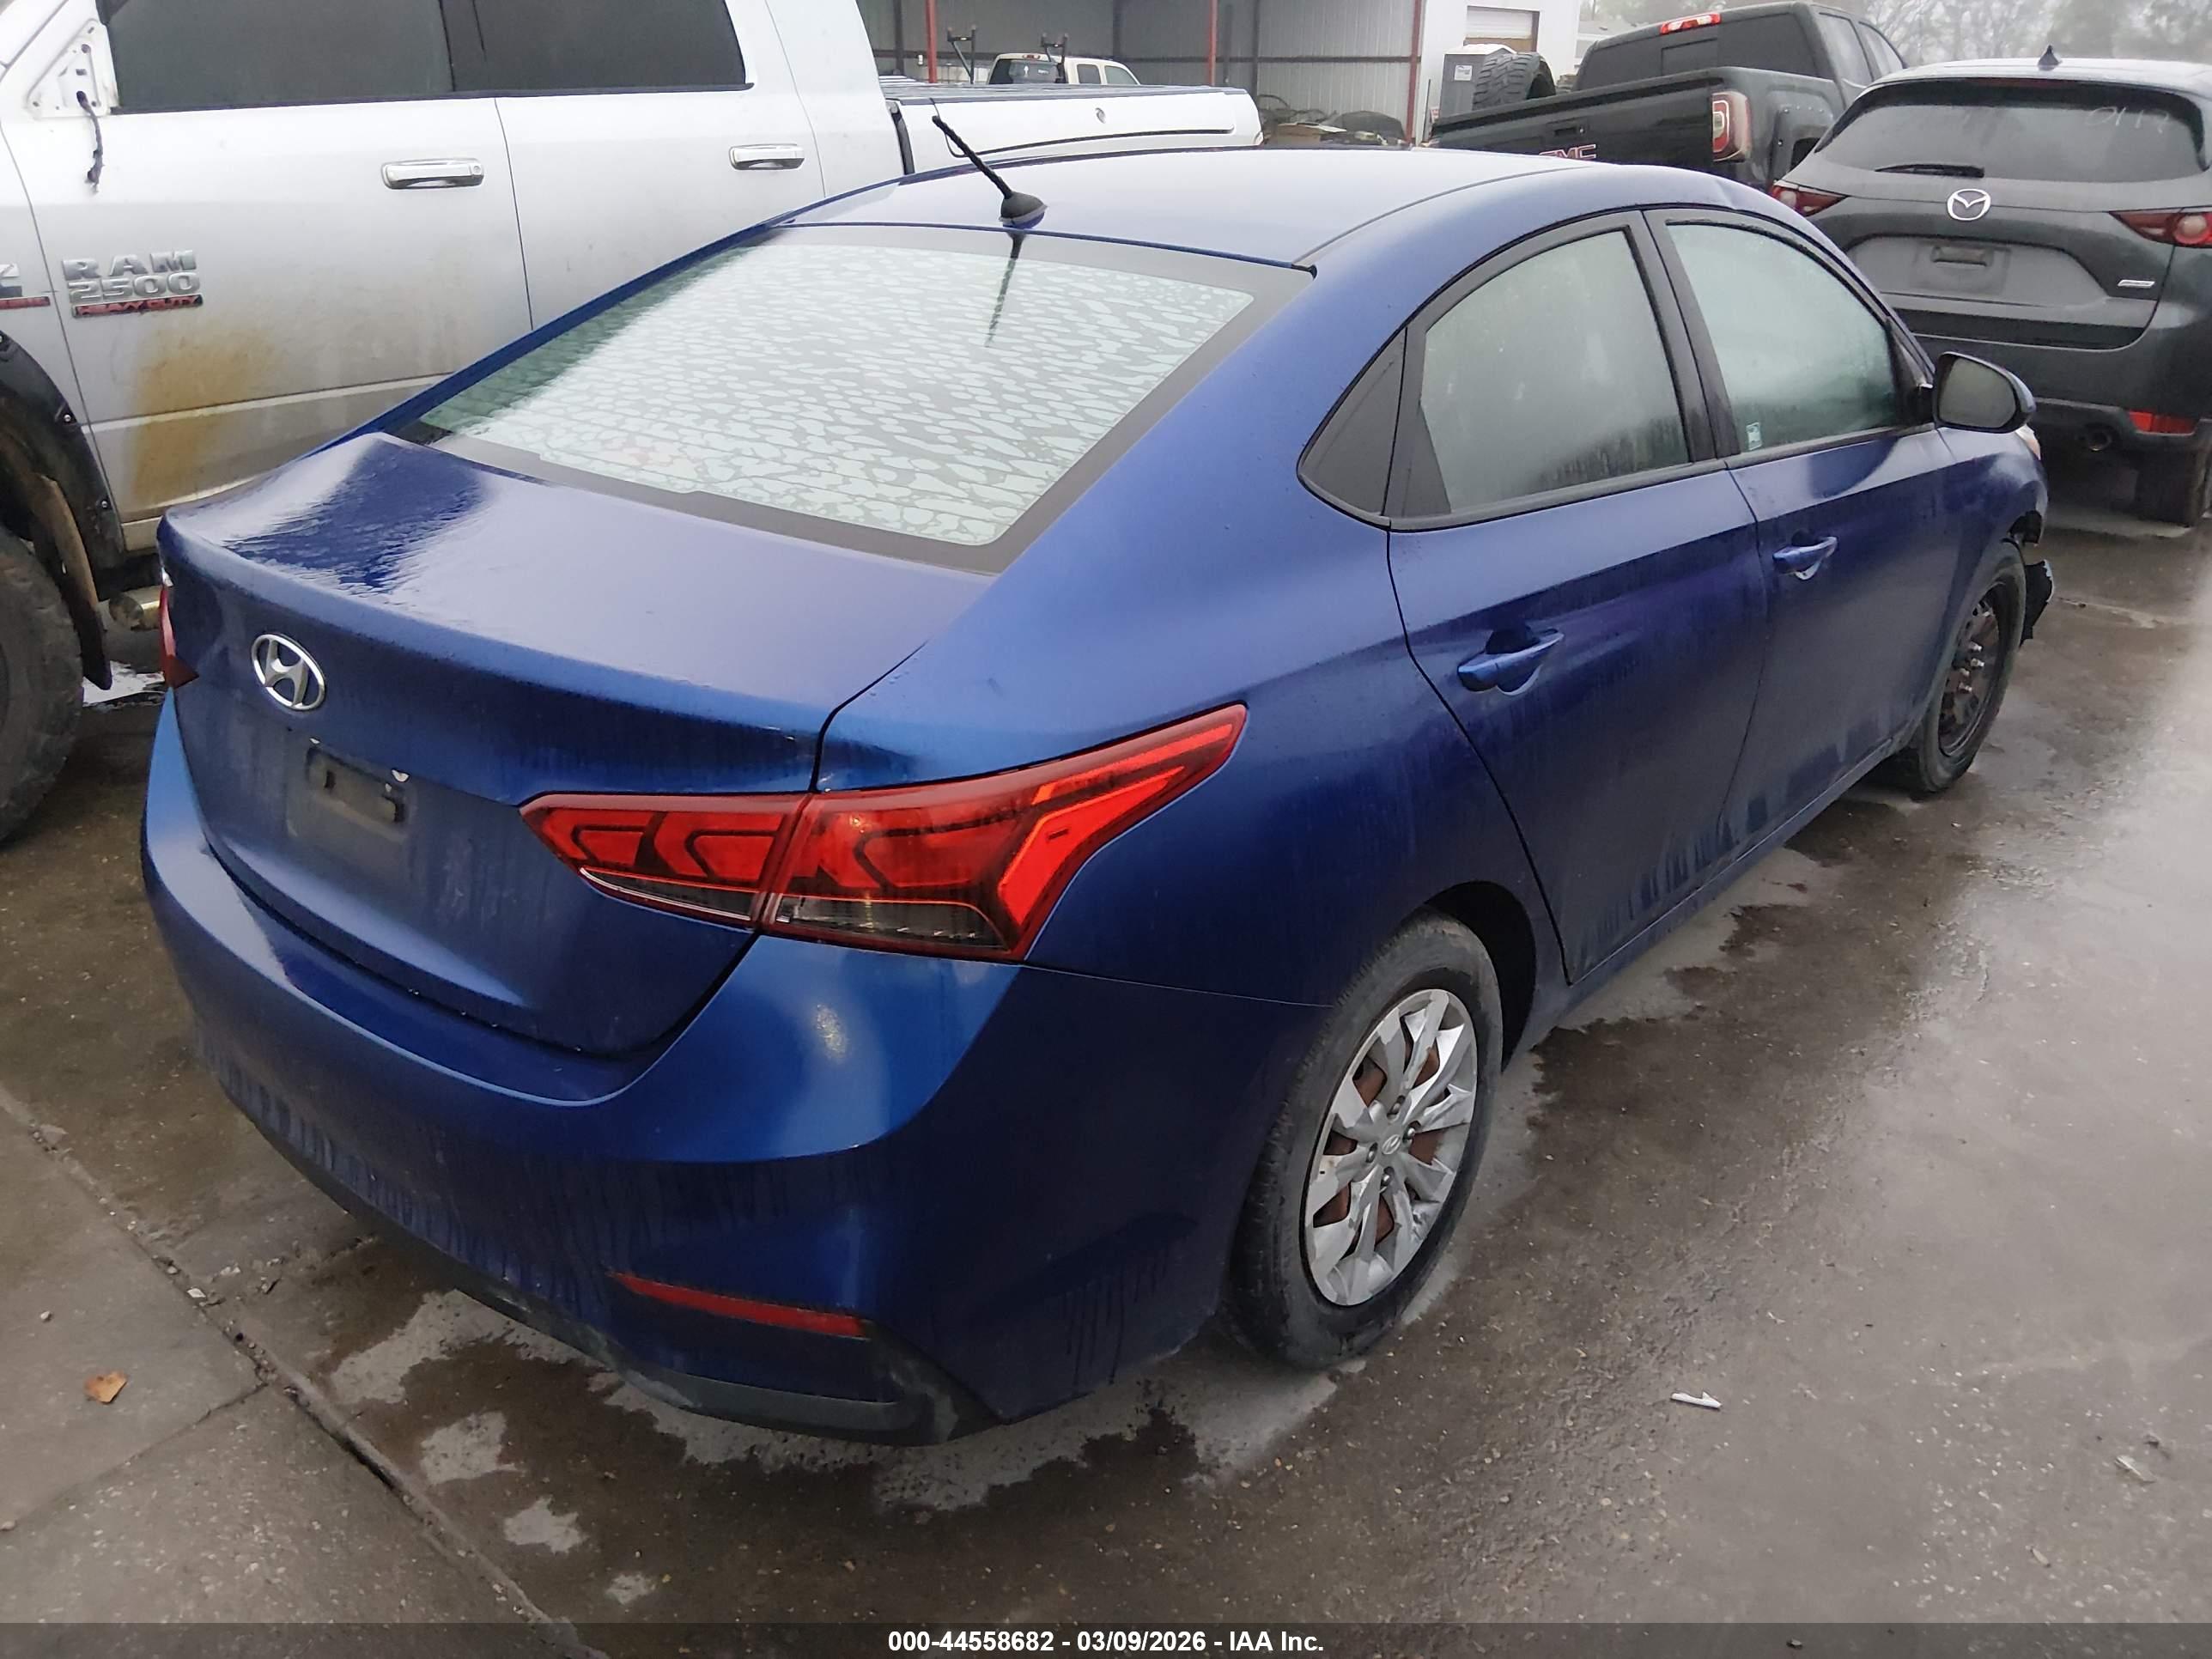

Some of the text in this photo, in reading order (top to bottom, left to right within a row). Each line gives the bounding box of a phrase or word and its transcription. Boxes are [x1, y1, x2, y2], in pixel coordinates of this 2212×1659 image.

[1538, 143, 1597, 161] MC
[62, 250, 198, 281] RAM
[67, 271, 201, 304] 2500
